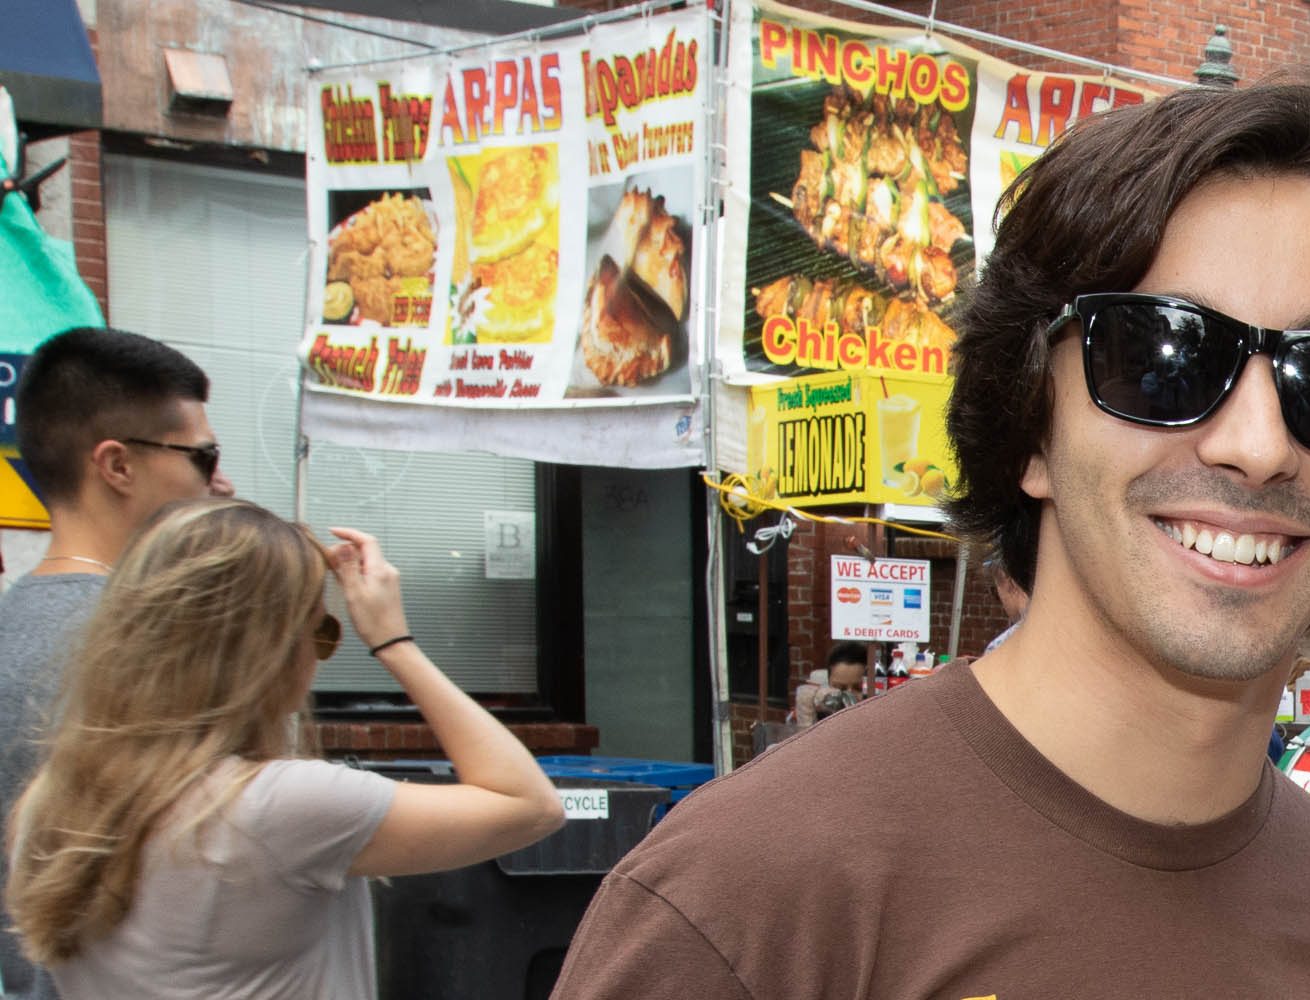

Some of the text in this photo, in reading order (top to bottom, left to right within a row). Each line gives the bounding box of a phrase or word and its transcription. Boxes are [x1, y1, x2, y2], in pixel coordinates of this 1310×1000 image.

[761, 20, 969, 110] PINCHOS
[438, 51, 563, 147] ARPAS
[764, 316, 948, 378] Chicken
[777, 412, 867, 498] LEMONADE
[837, 561, 926, 581] WE ACCEPT
[844, 627, 920, 640] & DEBIT CARDS
[560, 796, 607, 811] CYCLE
